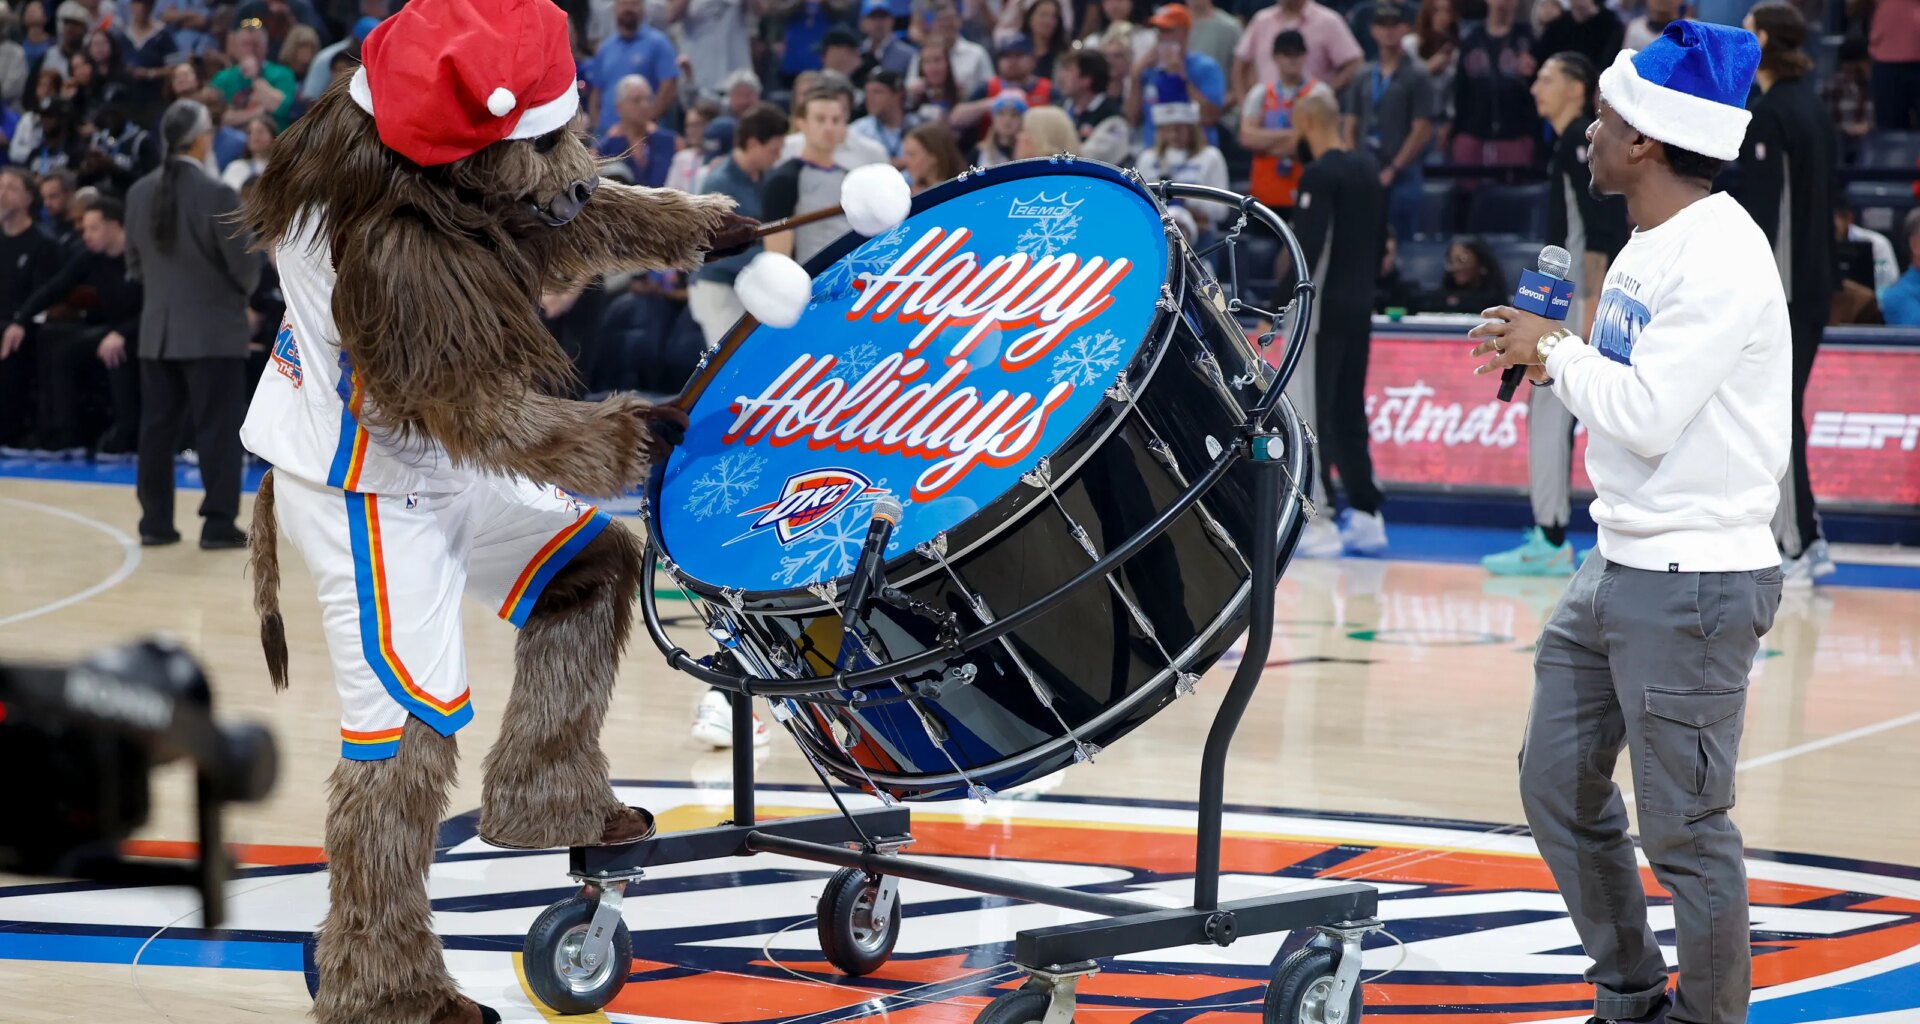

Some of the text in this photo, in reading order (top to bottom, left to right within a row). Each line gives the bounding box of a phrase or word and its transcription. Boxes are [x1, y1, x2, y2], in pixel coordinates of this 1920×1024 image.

[1014, 206, 1068, 215] REMO
[846, 227, 1133, 371] Happy
[1519, 285, 1545, 302] devon
[1551, 296, 1569, 307] devon
[722, 352, 1074, 502] Holidays
[1365, 380, 1529, 448] stmas
[757, 483, 850, 526] OKC
